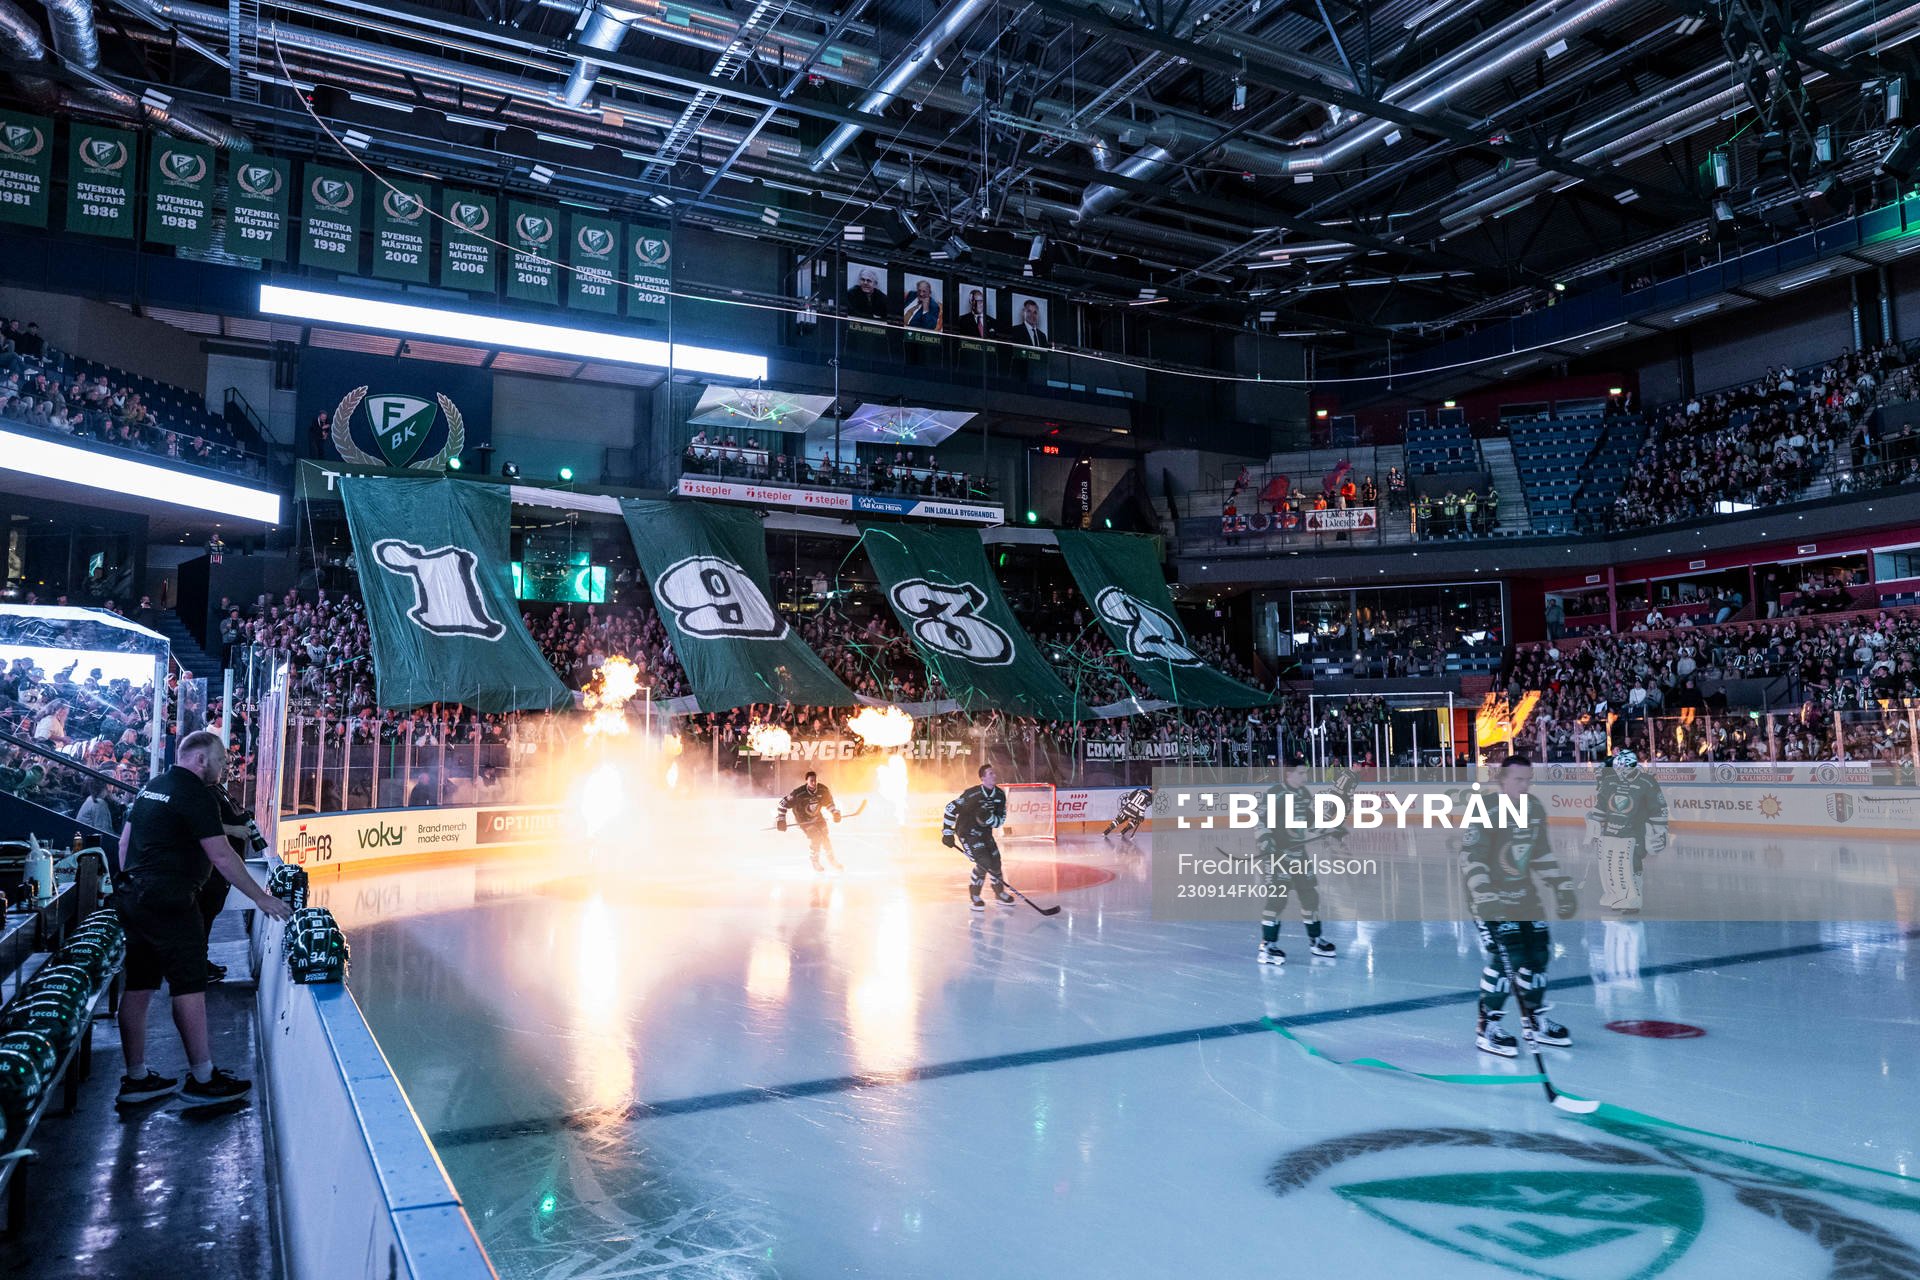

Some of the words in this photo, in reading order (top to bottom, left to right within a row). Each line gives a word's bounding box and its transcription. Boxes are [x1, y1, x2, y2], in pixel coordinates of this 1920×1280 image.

[0, 170, 40, 183] VENSKA
[0, 178, 40, 193] ÄSTARE
[77, 182, 126, 196] SVENSKA
[0, 191, 30, 206] 981
[77, 192, 125, 205] MÄSTARE
[157, 194, 204, 208] SVENSKA
[83, 204, 119, 218] 1986
[156, 203, 204, 217] MÄSTARE
[234, 207, 280, 220] SVENSKA
[162, 215, 197, 229] 1988
[234, 216, 280, 229] MÄSTARE
[309, 218, 352, 233] SVENSKA
[241, 228, 273, 241] 1997
[309, 227, 352, 241] MÄSTARE
[381, 231, 423, 244] SVENSKA
[313, 239, 346, 253] 1998
[381, 240, 423, 252] MÄSTARE
[449, 242, 488, 254] SVENSKA
[385, 251, 418, 264] 2002
[449, 250, 488, 262] MÄSTARE
[452, 261, 484, 274] 2006
[515, 262, 552, 274] MÄSTARE
[518, 273, 548, 286] 2009
[634, 275, 670, 286] SVENSKA
[581, 284, 606, 296] 2011
[638, 293, 666, 304] 2022
[382, 402, 405, 430] F
[696, 483, 732, 496] stepler
[757, 489, 792, 502] stepler
[815, 494, 849, 506] stepler
[924, 505, 935, 514] DIN
[936, 507, 959, 516] LOKALA
[1673, 799, 1753, 811] KARLSTAD.SE
[418, 825, 440, 834] Brand
[442, 822, 467, 832] merch
[418, 834, 440, 843] made
[441, 833, 459, 842] easy
[310, 951, 326, 962] 34
[43, 983, 68, 991] Lecab
[30, 1010, 59, 1018] Lecab
